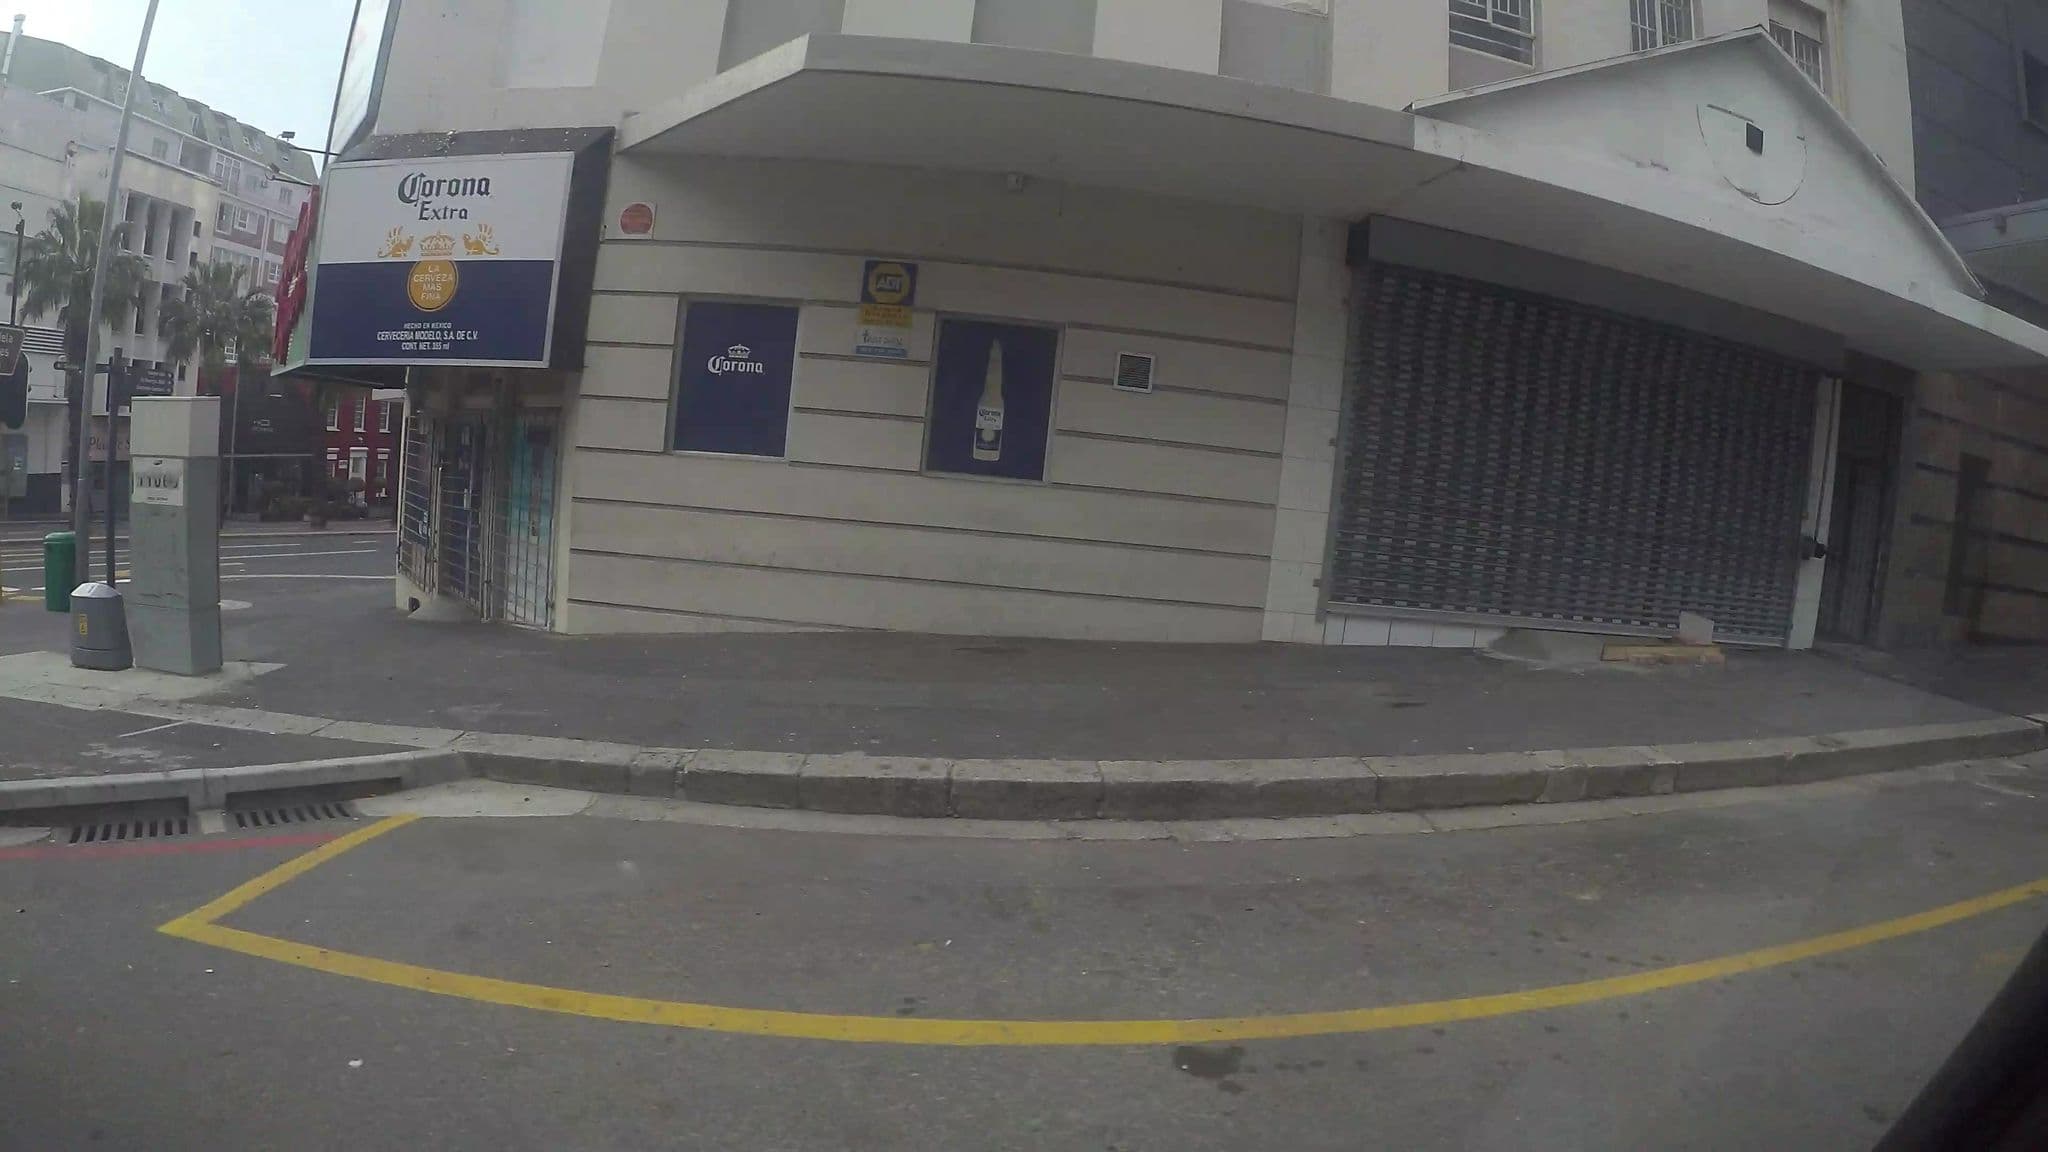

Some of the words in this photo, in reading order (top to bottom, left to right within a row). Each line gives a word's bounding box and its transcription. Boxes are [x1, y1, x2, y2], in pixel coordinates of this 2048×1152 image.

[397, 172, 491, 207] Corona
[418, 200, 468, 221] Extra
[413, 274, 453, 283] CERVEZA
[707, 355, 763, 376] Corona
